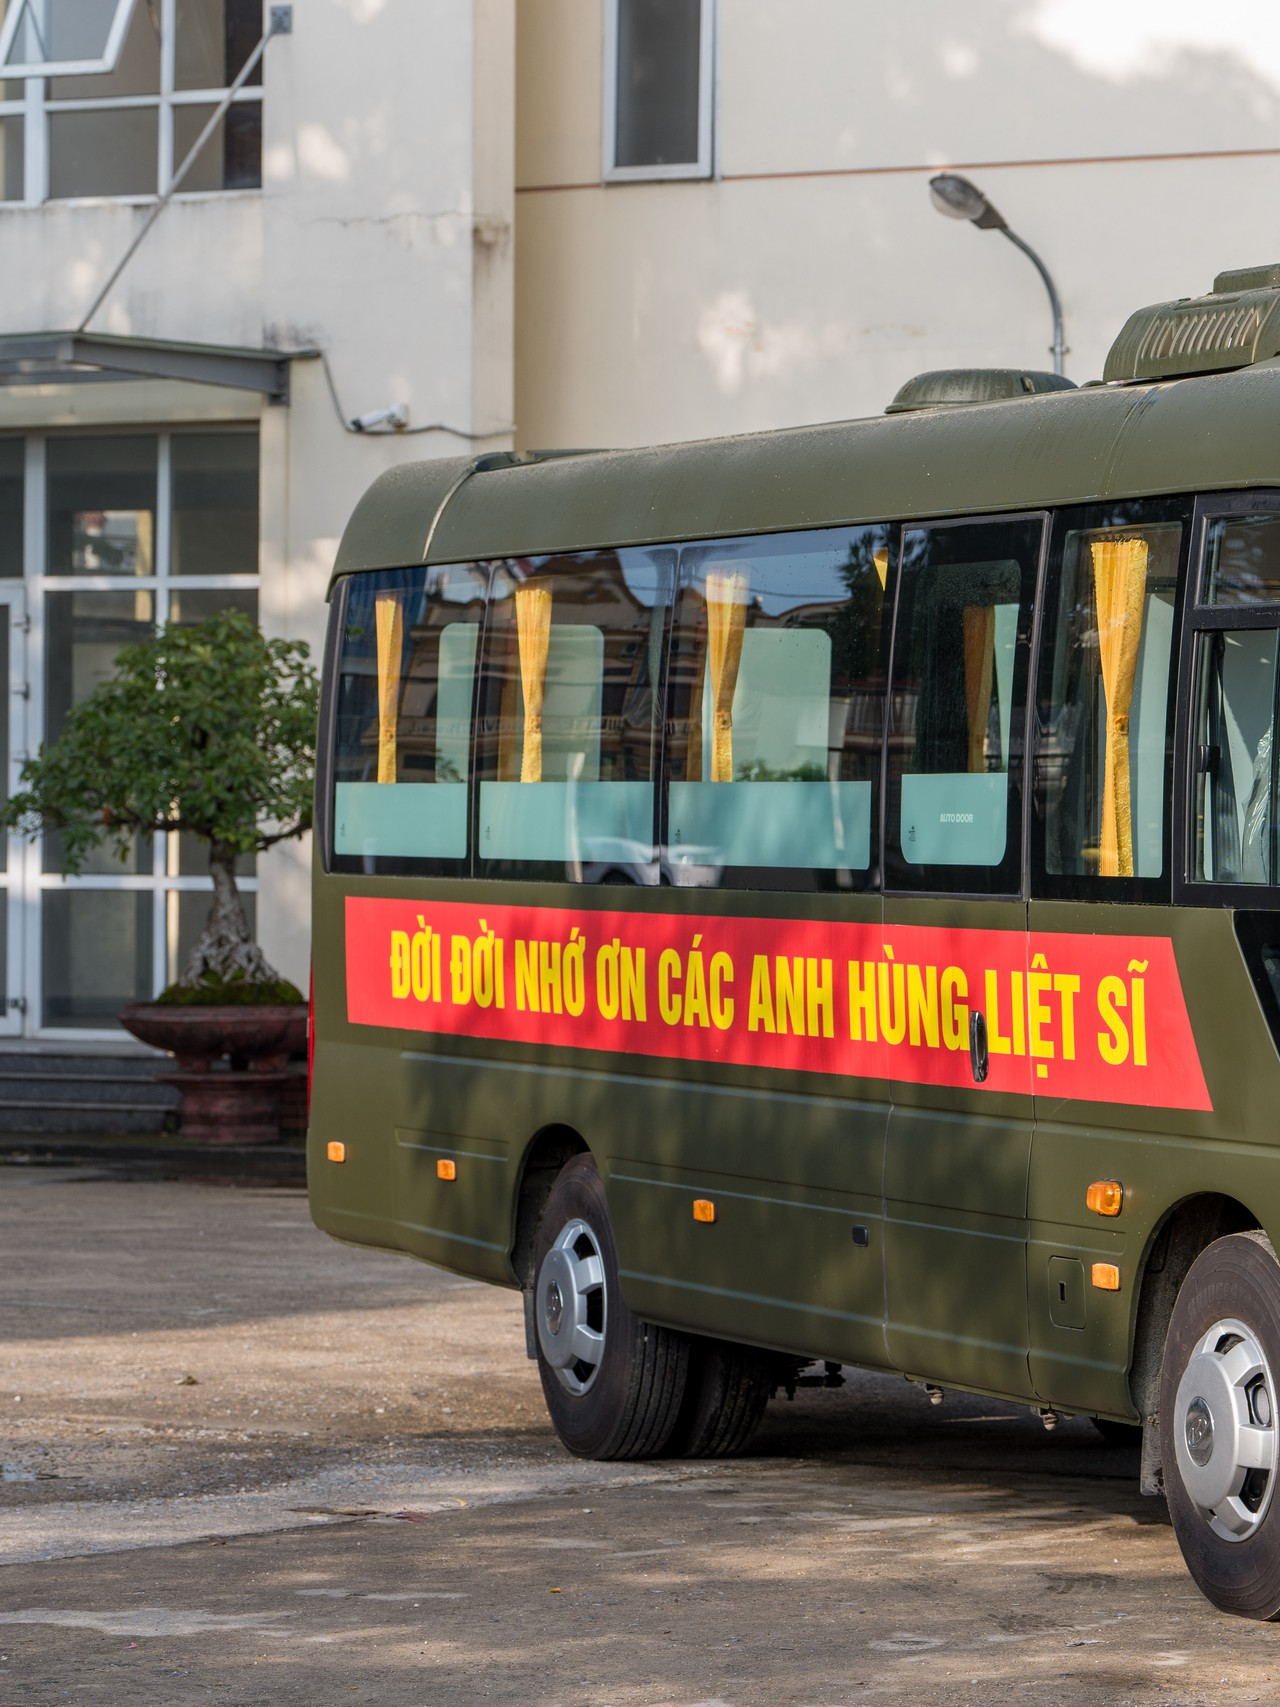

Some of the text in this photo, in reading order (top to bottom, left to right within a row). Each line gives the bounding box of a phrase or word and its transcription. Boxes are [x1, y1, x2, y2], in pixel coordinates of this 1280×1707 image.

[940, 813, 974, 823] AUTO DOOR
[389, 914, 1149, 1080] ĐỜI ĐỜI NHỚ ƠN CÁC ANH HÙNG LIỆT SĨ
